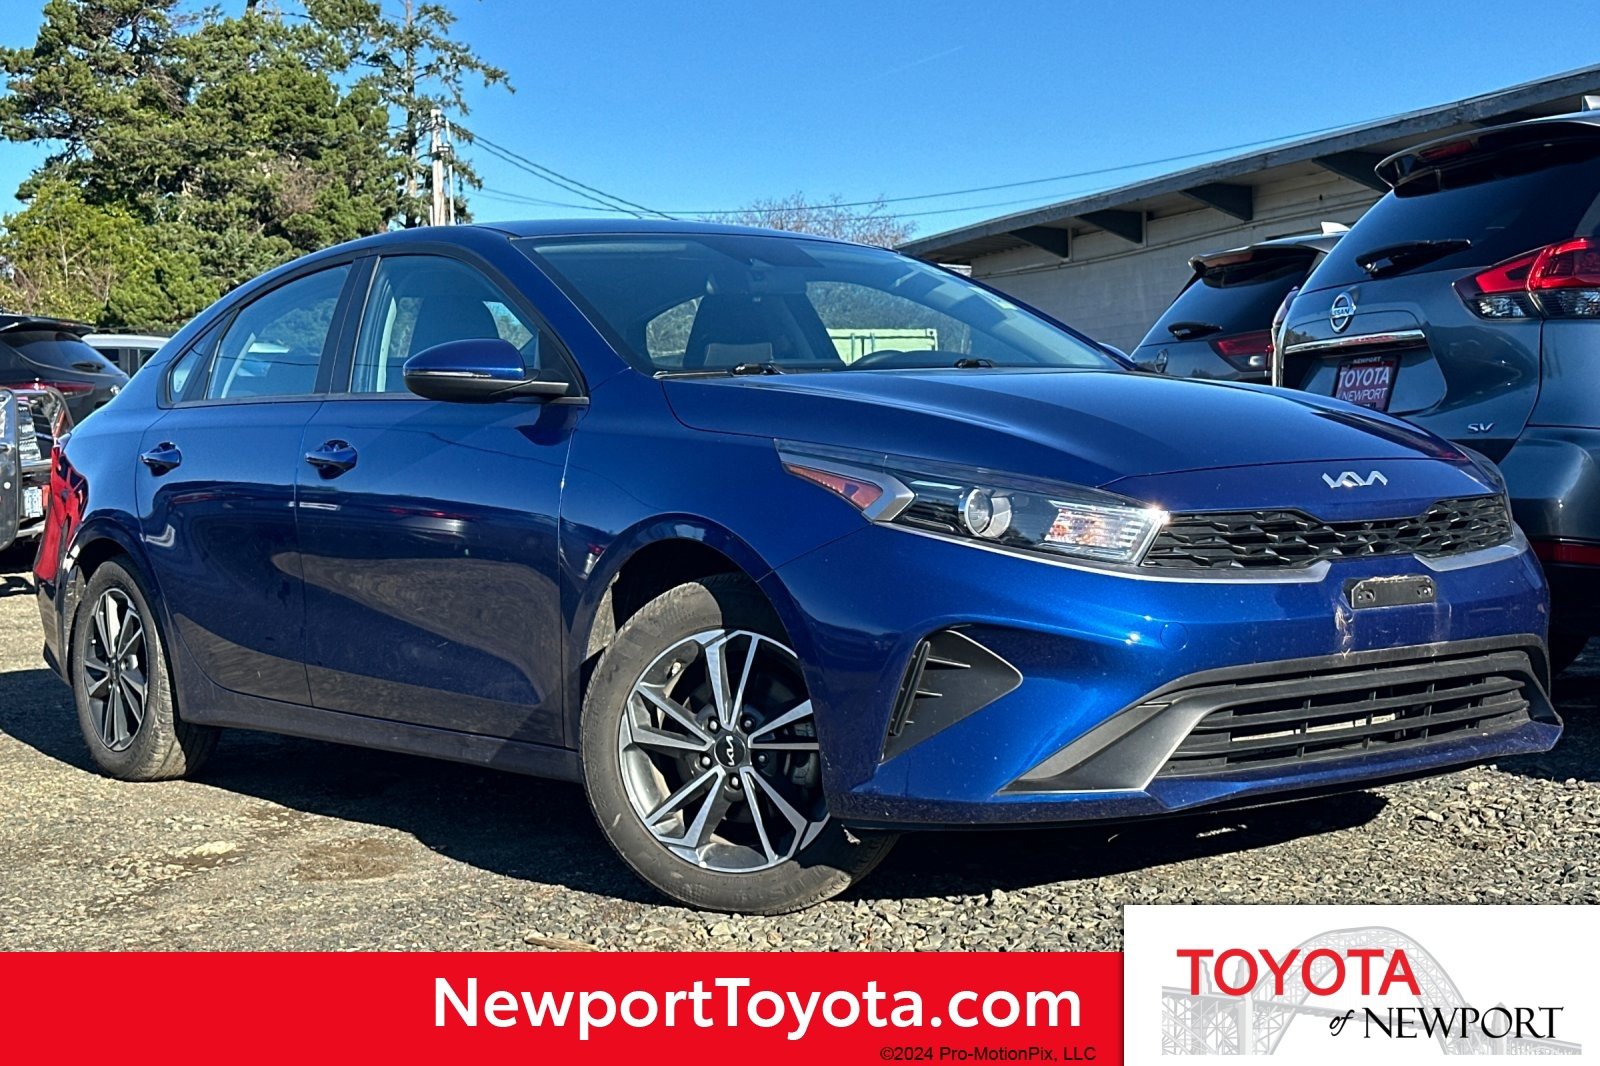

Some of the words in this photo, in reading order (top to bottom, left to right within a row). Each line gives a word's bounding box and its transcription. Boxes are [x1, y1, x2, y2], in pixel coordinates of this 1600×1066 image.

[1339, 366, 1390, 388] TOYOTA
[1341, 387, 1388, 402] NEWPORT
[1467, 422, 1494, 432] SV
